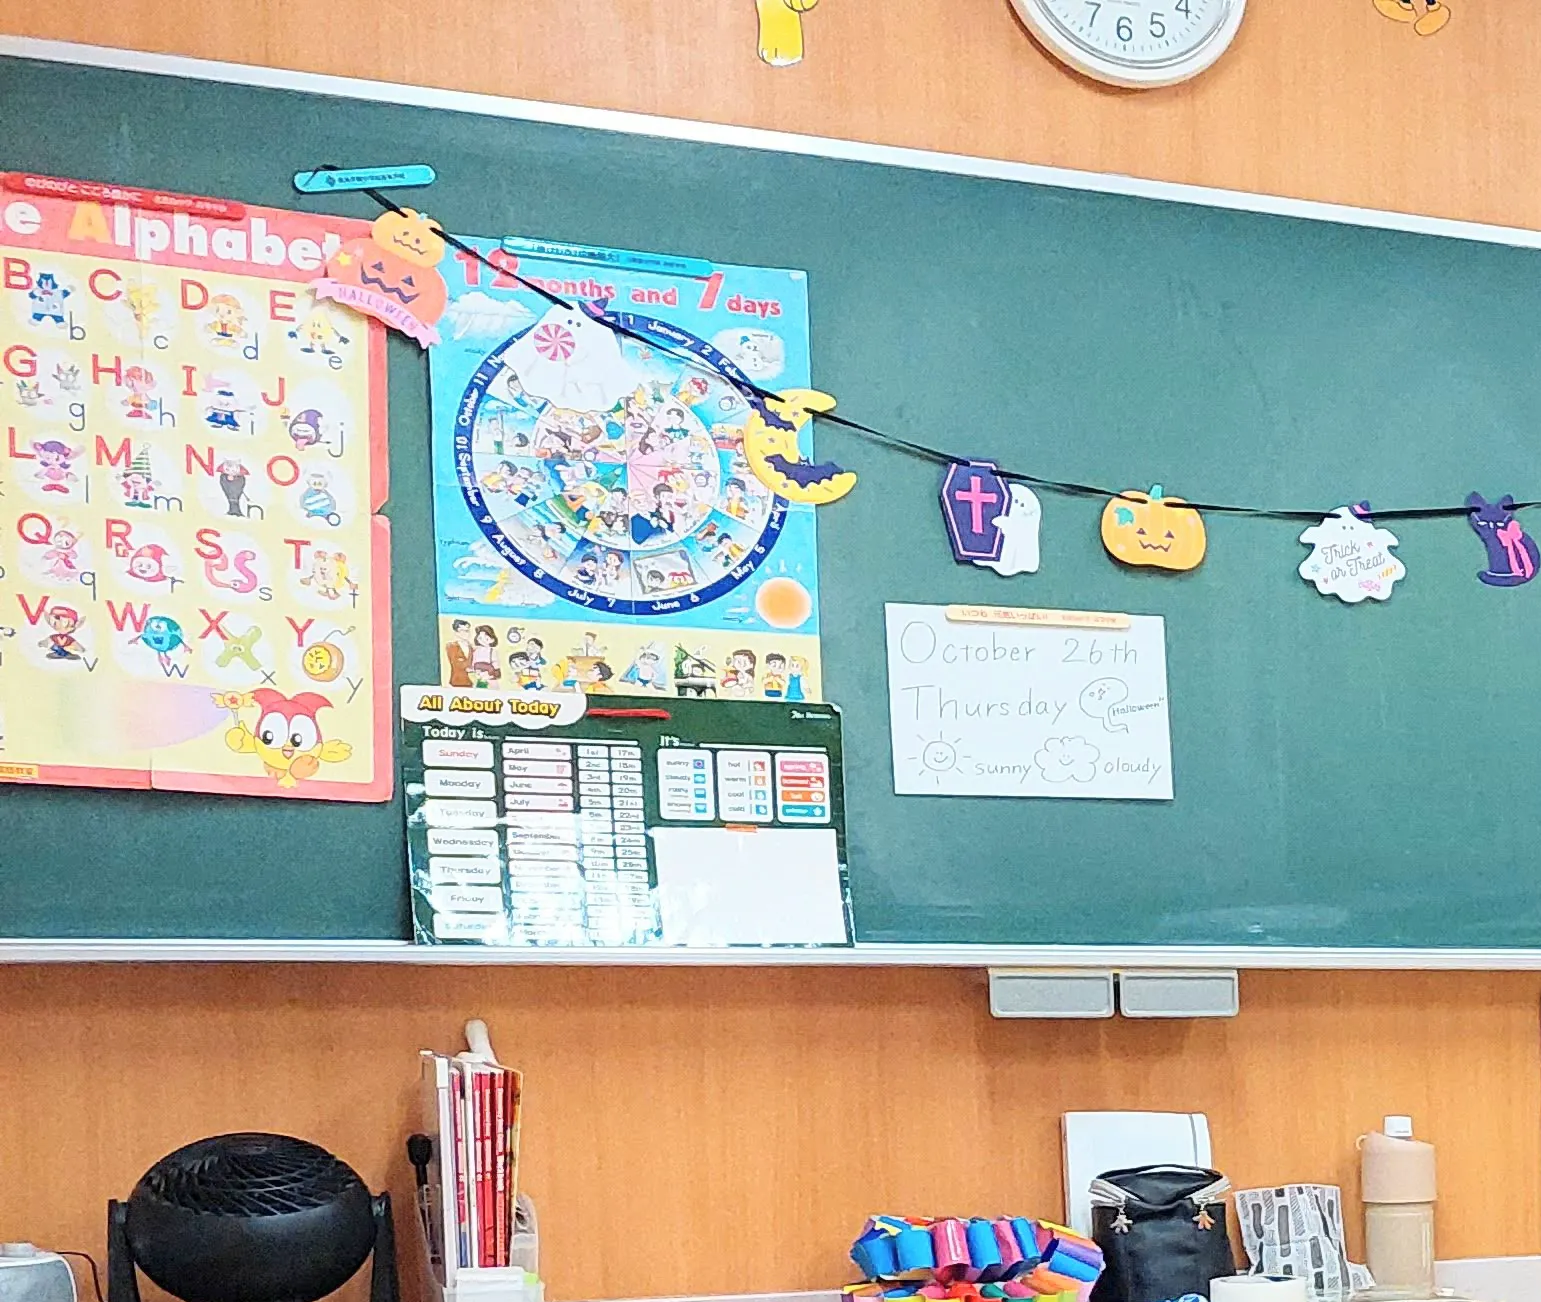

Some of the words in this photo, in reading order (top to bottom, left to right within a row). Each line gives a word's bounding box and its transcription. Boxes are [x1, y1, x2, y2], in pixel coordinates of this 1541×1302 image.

[1085, 1, 1101, 27] 7
[1116, 16, 1133, 42] 6
[1150, 12, 1165, 38] 5
[67, 202, 344, 271] Alphabet
[3, 257, 32, 290] B
[89, 270, 122, 301] C
[181, 279, 208, 311] D
[270, 291, 296, 322] E
[631, 282, 678, 306] and
[695, 272, 725, 311] 7
[726, 293, 782, 318] days
[648, 321, 695, 347] January
[3, 345, 37, 377] G
[92, 354, 122, 386] H
[182, 366, 198, 397] I
[261, 377, 285, 407] J
[8, 427, 36, 459] L
[96, 435, 132, 466] M
[186, 445, 214, 477] N
[266, 455, 300, 487] O
[17, 513, 51, 545] Q
[105, 519, 133, 549] R
[194, 528, 223, 560] S
[283, 539, 311, 569] T
[1321, 540, 1360, 564] Trick
[1346, 552, 1385, 576] Treat
[567, 589, 595, 605] July
[652, 600, 680, 611] June
[16, 594, 50, 626] V
[106, 600, 150, 632] W
[199, 609, 230, 640] X
[286, 616, 314, 647] Y
[900, 621, 1036, 664] October
[419, 695, 443, 710] All
[450, 696, 503, 712] About
[508, 699, 561, 717] Today
[901, 685, 1067, 725] Thursday
[422, 725, 466, 739] Today
[438, 749, 479, 760] Sunday
[975, 764, 1032, 784] sunny
